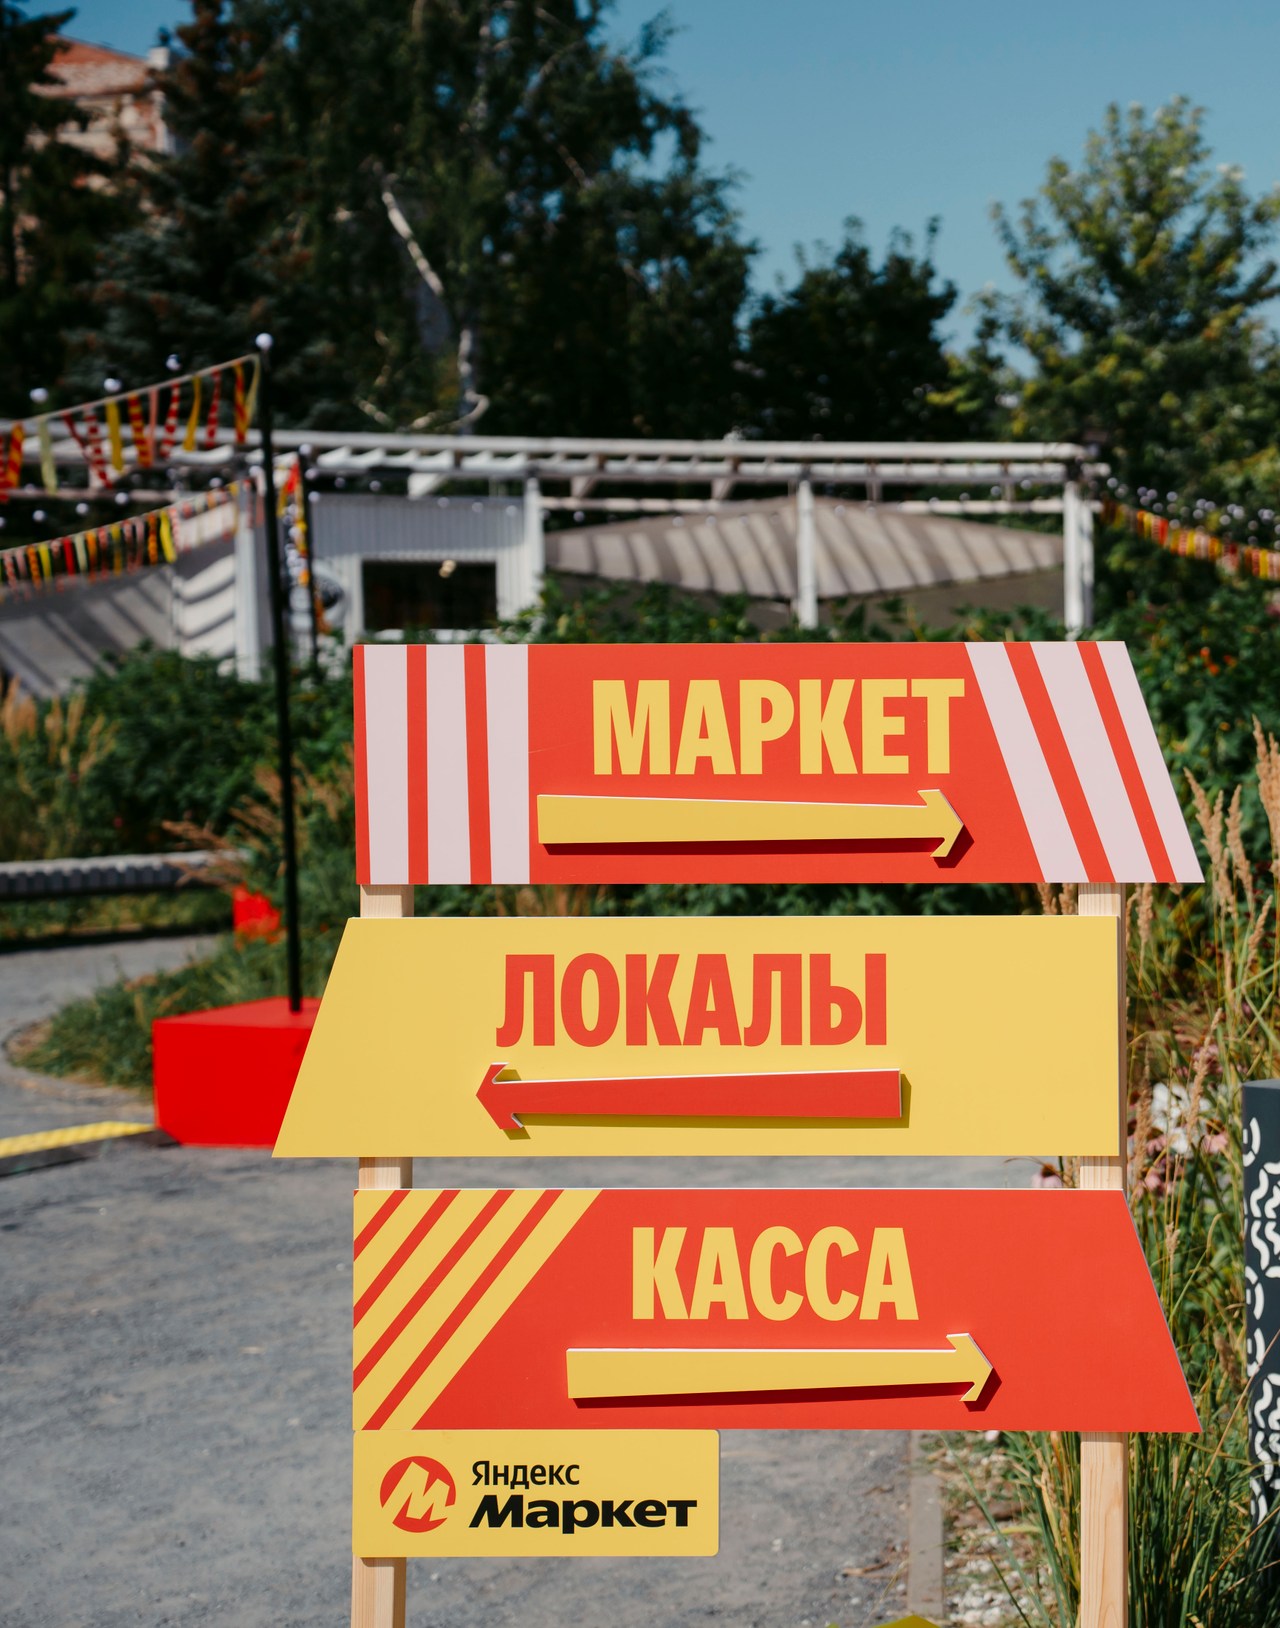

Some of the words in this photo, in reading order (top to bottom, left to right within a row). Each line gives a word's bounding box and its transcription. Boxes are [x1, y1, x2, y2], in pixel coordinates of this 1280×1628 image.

[593, 679, 965, 776] МАРКЕТ
[496, 953, 888, 1048] ЛОКАЛЫ
[633, 1226, 920, 1322] КАССА
[468, 1494, 698, 1535] Маркет
[471, 1460, 581, 1490] Яндекс
